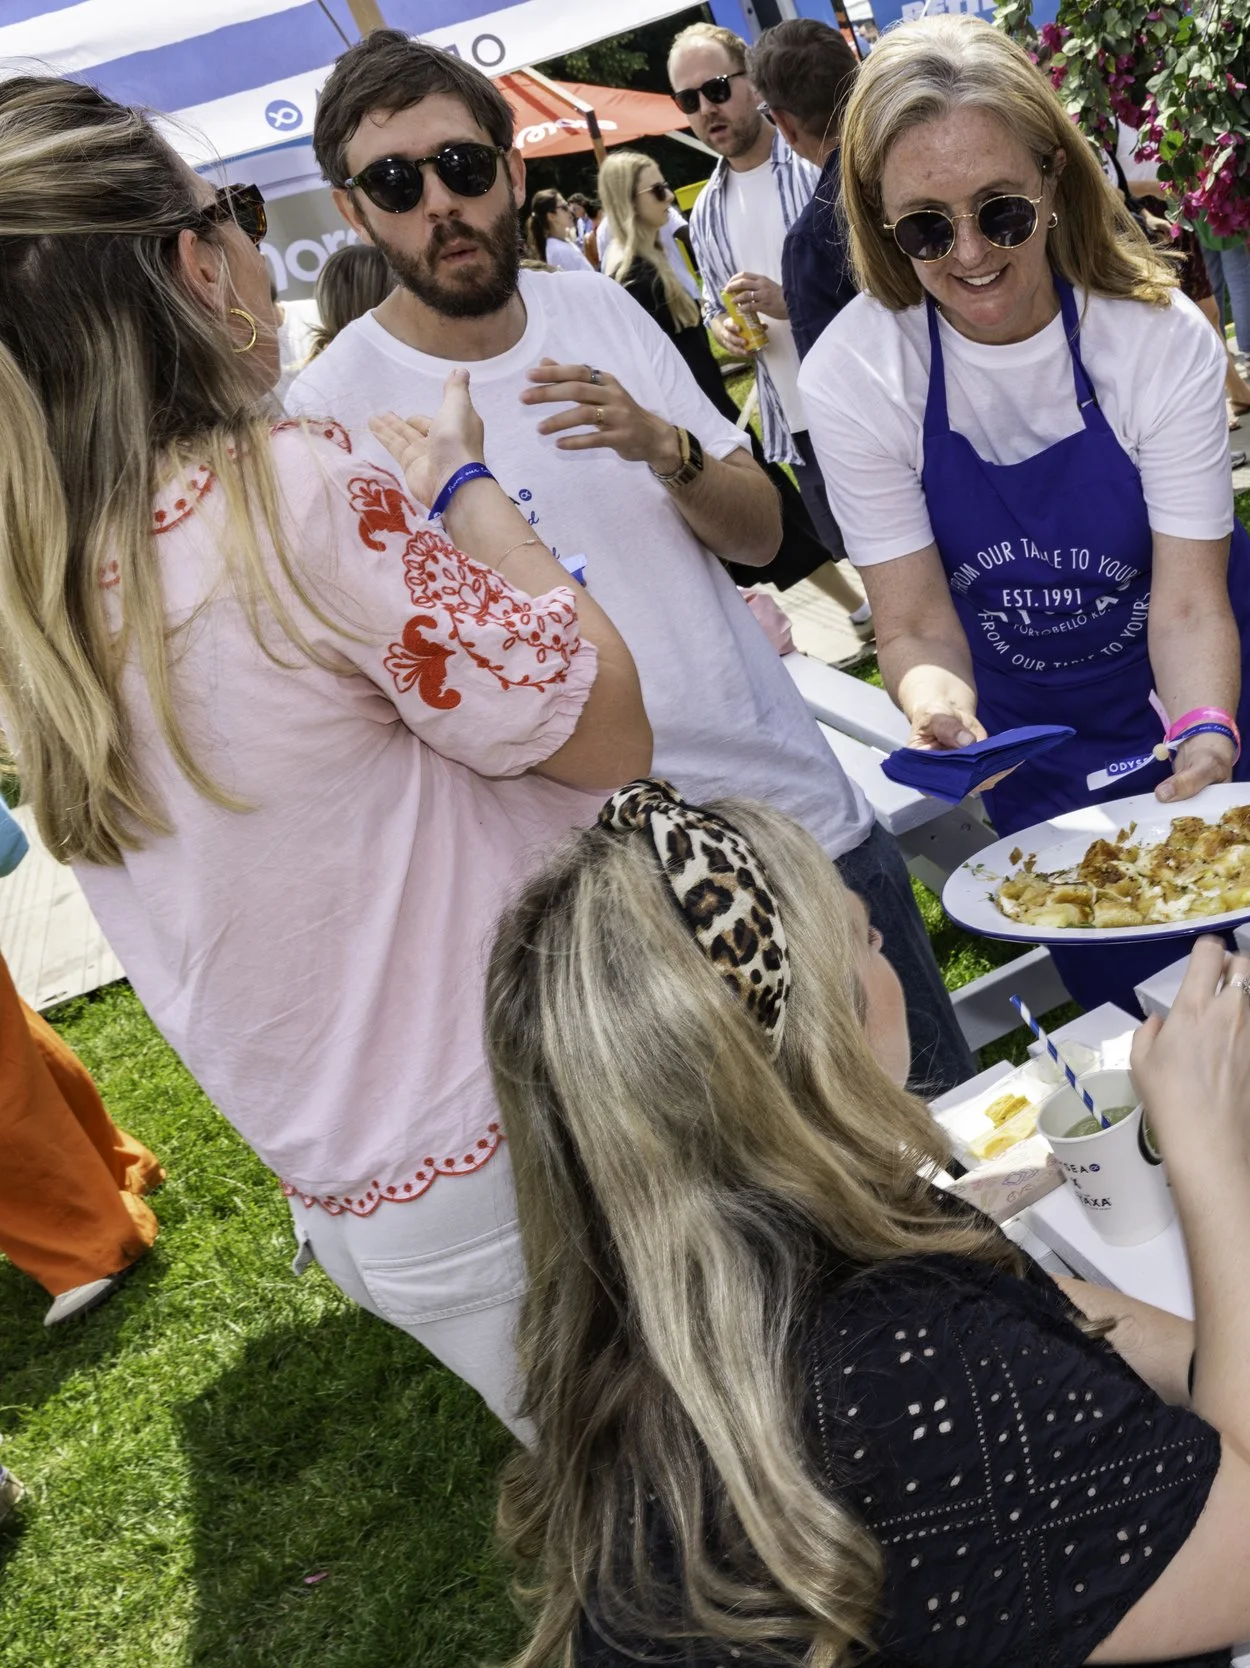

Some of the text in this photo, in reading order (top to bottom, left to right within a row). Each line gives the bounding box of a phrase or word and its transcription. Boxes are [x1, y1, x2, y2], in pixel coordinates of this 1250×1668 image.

[977, 541, 1016, 570] OUR
[1020, 538, 1063, 569] TAE
[1070, 548, 1090, 570] TO
[977, 611, 1010, 655] FROM
[1011, 653, 1046, 672] OUR
[1100, 641, 1124, 657] TO
